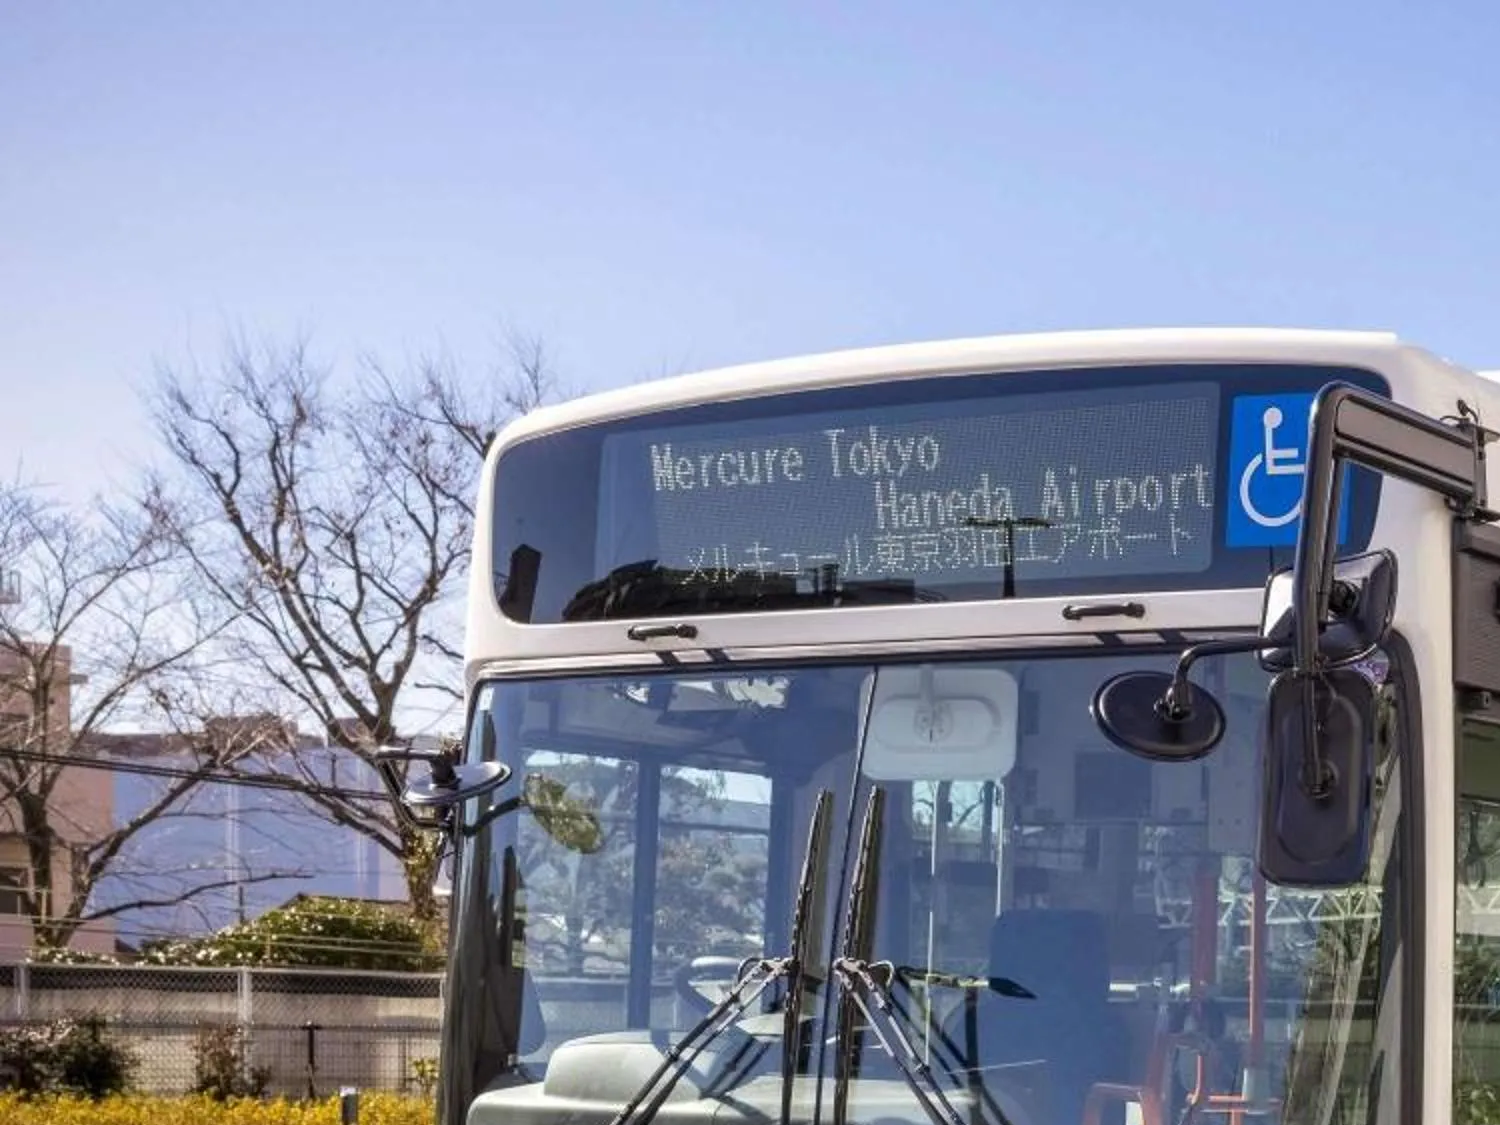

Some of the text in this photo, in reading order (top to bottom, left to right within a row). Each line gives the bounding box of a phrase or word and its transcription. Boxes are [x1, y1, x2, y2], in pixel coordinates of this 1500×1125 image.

[650, 425, 941, 491] Mercure Tokyo
[874, 463, 1214, 530] Haneda Airport
